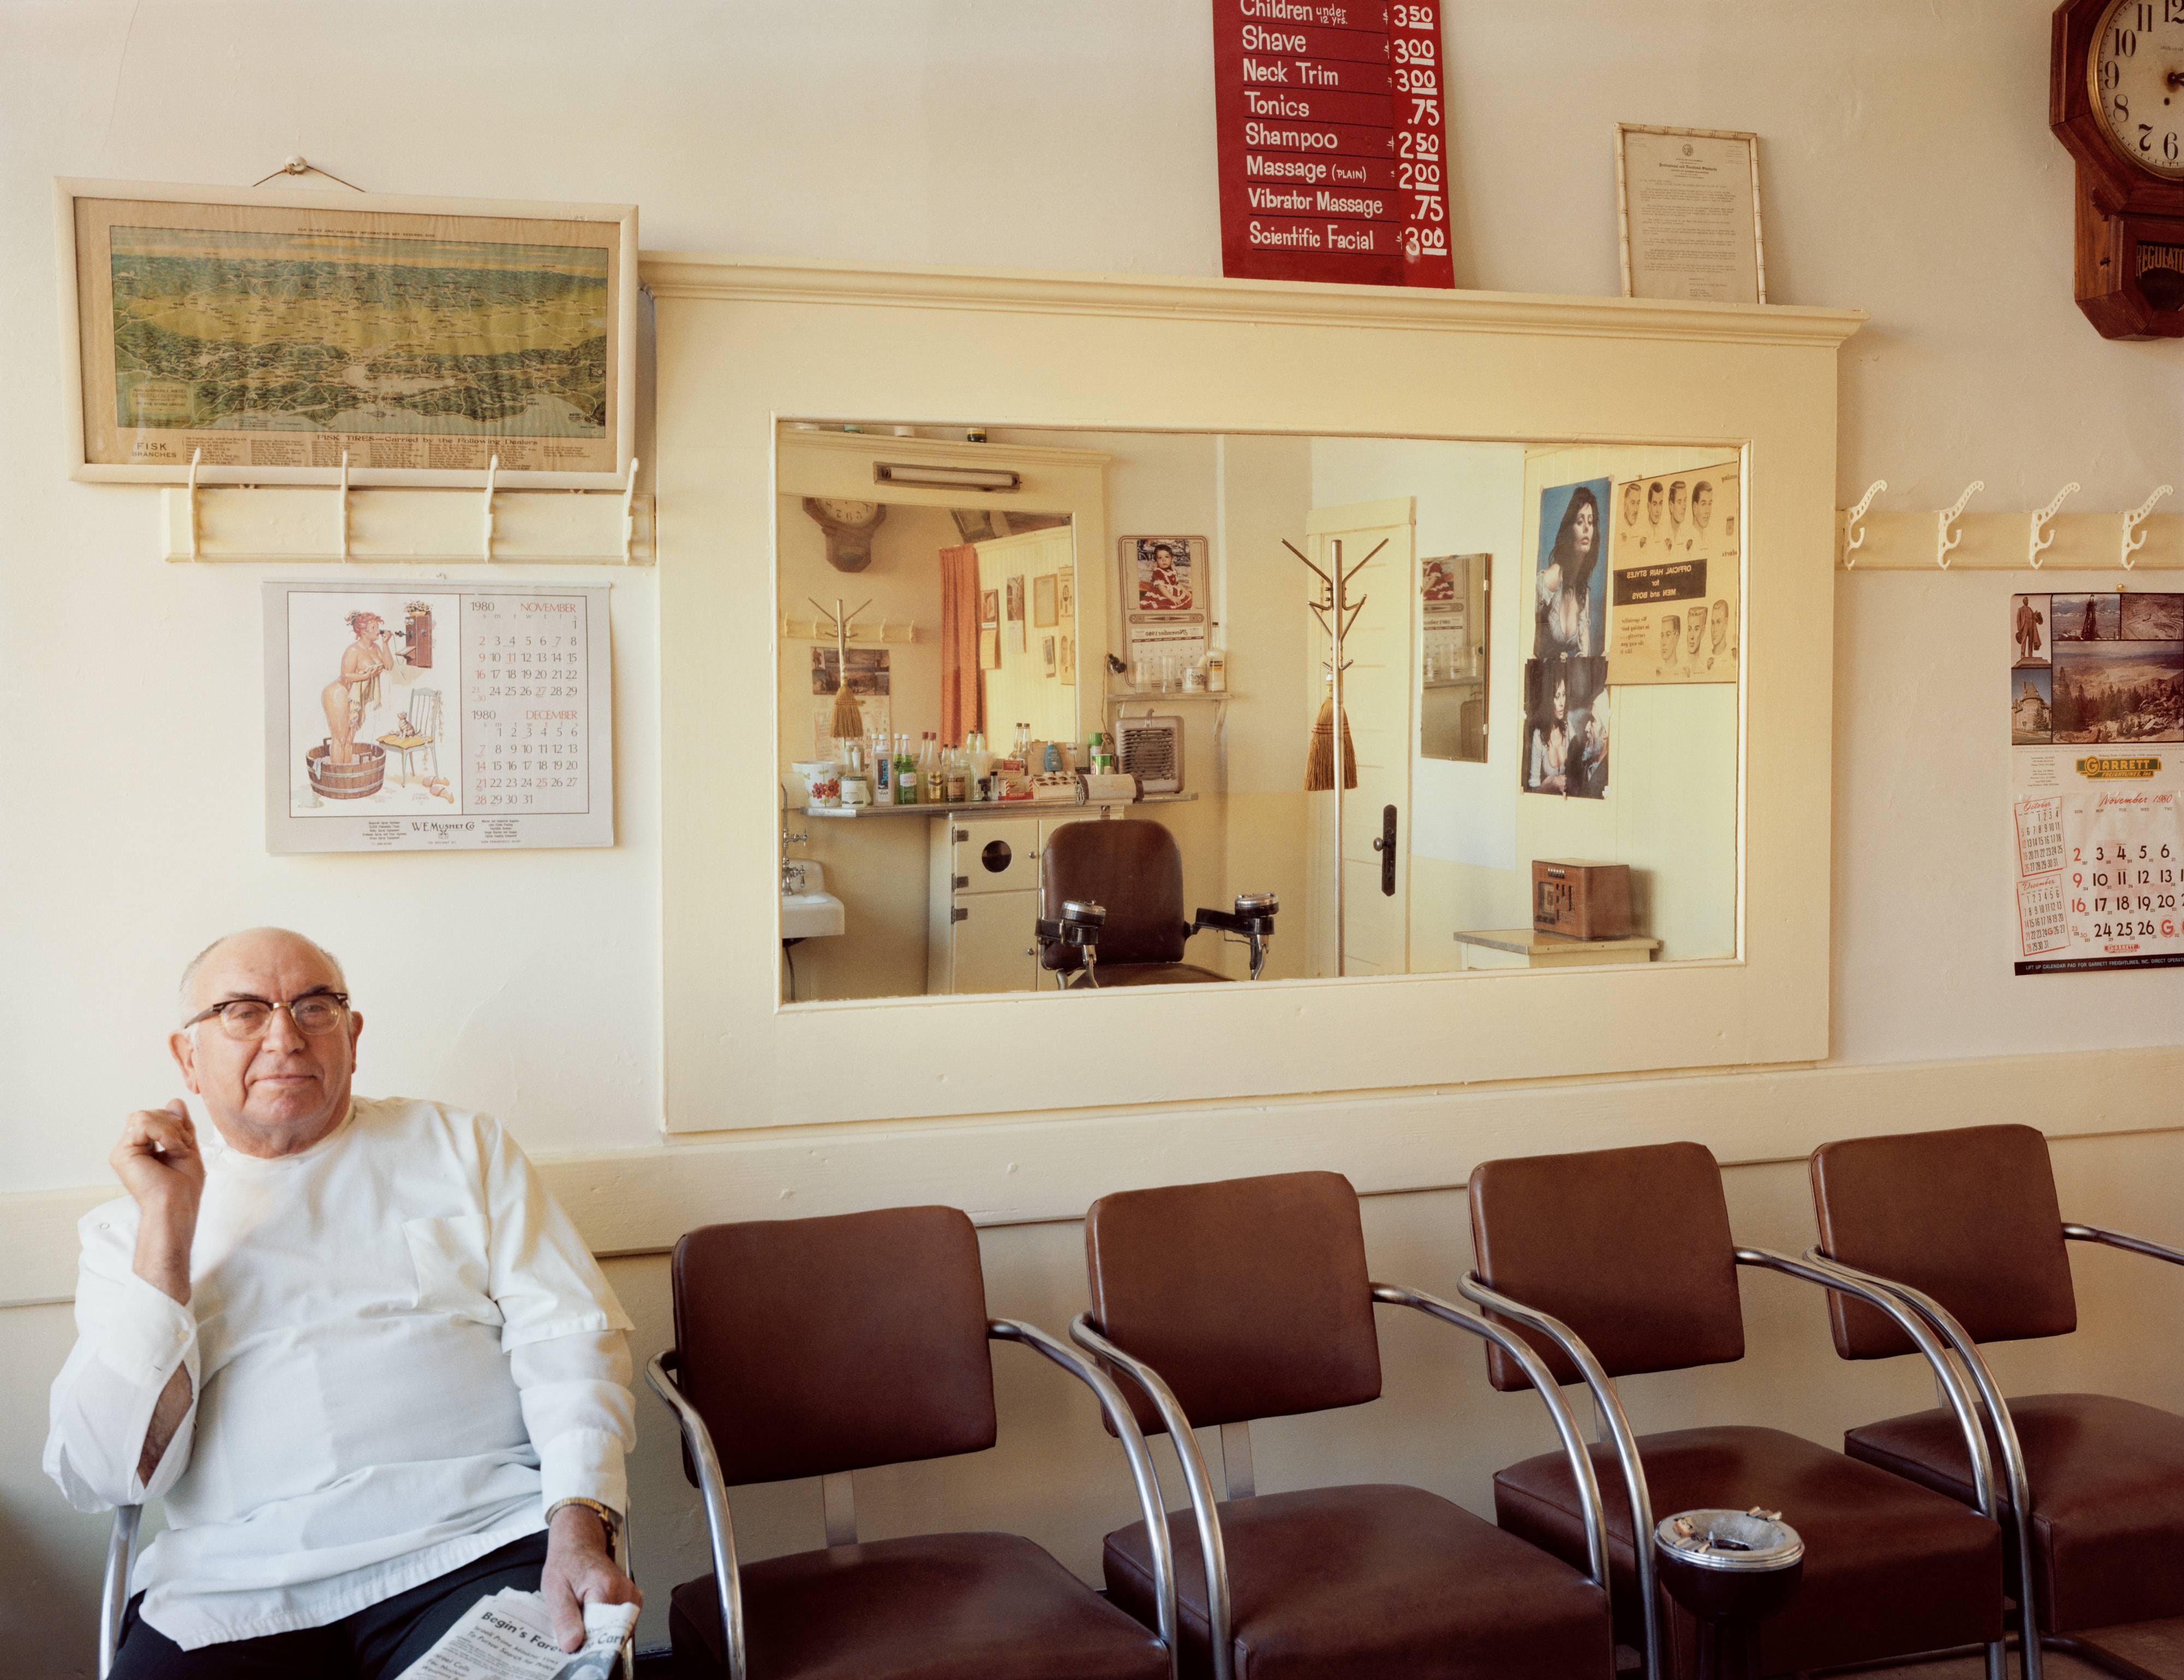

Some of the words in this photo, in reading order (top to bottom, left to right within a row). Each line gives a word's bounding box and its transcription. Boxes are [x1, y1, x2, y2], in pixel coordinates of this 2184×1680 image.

[1241, 0, 1313, 20] Children
[1316, 4, 1346, 17] under
[2137, 4, 2152, 32] 11
[1332, 17, 1348, 26] yrs.
[1242, 25, 1306, 52] Shave
[2115, 28, 2136, 57] 10
[1243, 58, 1288, 82] Neck
[1296, 62, 1339, 86] Trim
[2104, 60, 2120, 90] 9
[1244, 91, 1309, 117] Tonics
[1408, 99, 1439, 126] .75
[2113, 94, 2129, 122] 8
[1245, 122, 1338, 151] Shampoo
[2138, 123, 2153, 152] 7
[2163, 132, 2179, 161] 6
[1247, 156, 1327, 184] Massage
[1332, 166, 1367, 183] (PLAIN)
[1248, 188, 1313, 210] Vibrator
[1316, 193, 1383, 218] Massage
[1410, 195, 1443, 221] .75
[1250, 221, 1321, 247] Scientific
[1327, 225, 1374, 250] Facial
[137, 442, 167, 450] FISK
[471, 602, 494, 611] 1980
[520, 603, 576, 613] NOVEMBER
[573, 621, 577, 629] 1
[480, 637, 485, 645] 2
[495, 637, 501, 645] 3
[509, 637, 515, 645] 4
[526, 637, 531, 645] 5
[540, 637, 546, 645] 6
[555, 637, 561, 645] 7
[571, 637, 577, 646] 8
[479, 654, 485, 662] 9
[491, 654, 501, 662] 10
[507, 654, 515, 662] 11
[521, 654, 531, 662] 12
[537, 654, 547, 662] 13
[551, 654, 562, 662] 14
[567, 654, 577, 662] 15
[471, 710, 495, 720] 1980
[526, 710, 577, 720] DECEMBER
[2086, 757, 2150, 774] GARRETT
[2023, 800, 2051, 811] October
[2099, 793, 2147, 806] November
[2153, 794, 2173, 803] 1980
[2074, 847, 2081, 862] 2
[2096, 847, 2104, 860] 3
[2117, 846, 2126, 859] 4
[2139, 845, 2147, 859] 5
[2161, 844, 2170, 858] 6
[2022, 878, 2055, 891] December
[2073, 873, 2082, 888] 9
[2093, 873, 2108, 886] 10
[2118, 871, 2126, 884] 11
[2138, 870, 2149, 883] 12
[2161, 870, 2172, 883] 13
[2072, 898, 2086, 912] 16
[2095, 898, 2107, 911] 17
[2117, 896, 2129, 910] 18
[2138, 896, 2150, 911] 19
[2158, 894, 2175, 908] 20
[2094, 923, 2112, 937] 24
[2117, 922, 2133, 936] 25
[2138, 921, 2155, 935] 26
[481, 1611, 527, 1639] Begin's
[494, 1635, 513, 1647] Prime
[498, 1648, 523, 1661] Search
